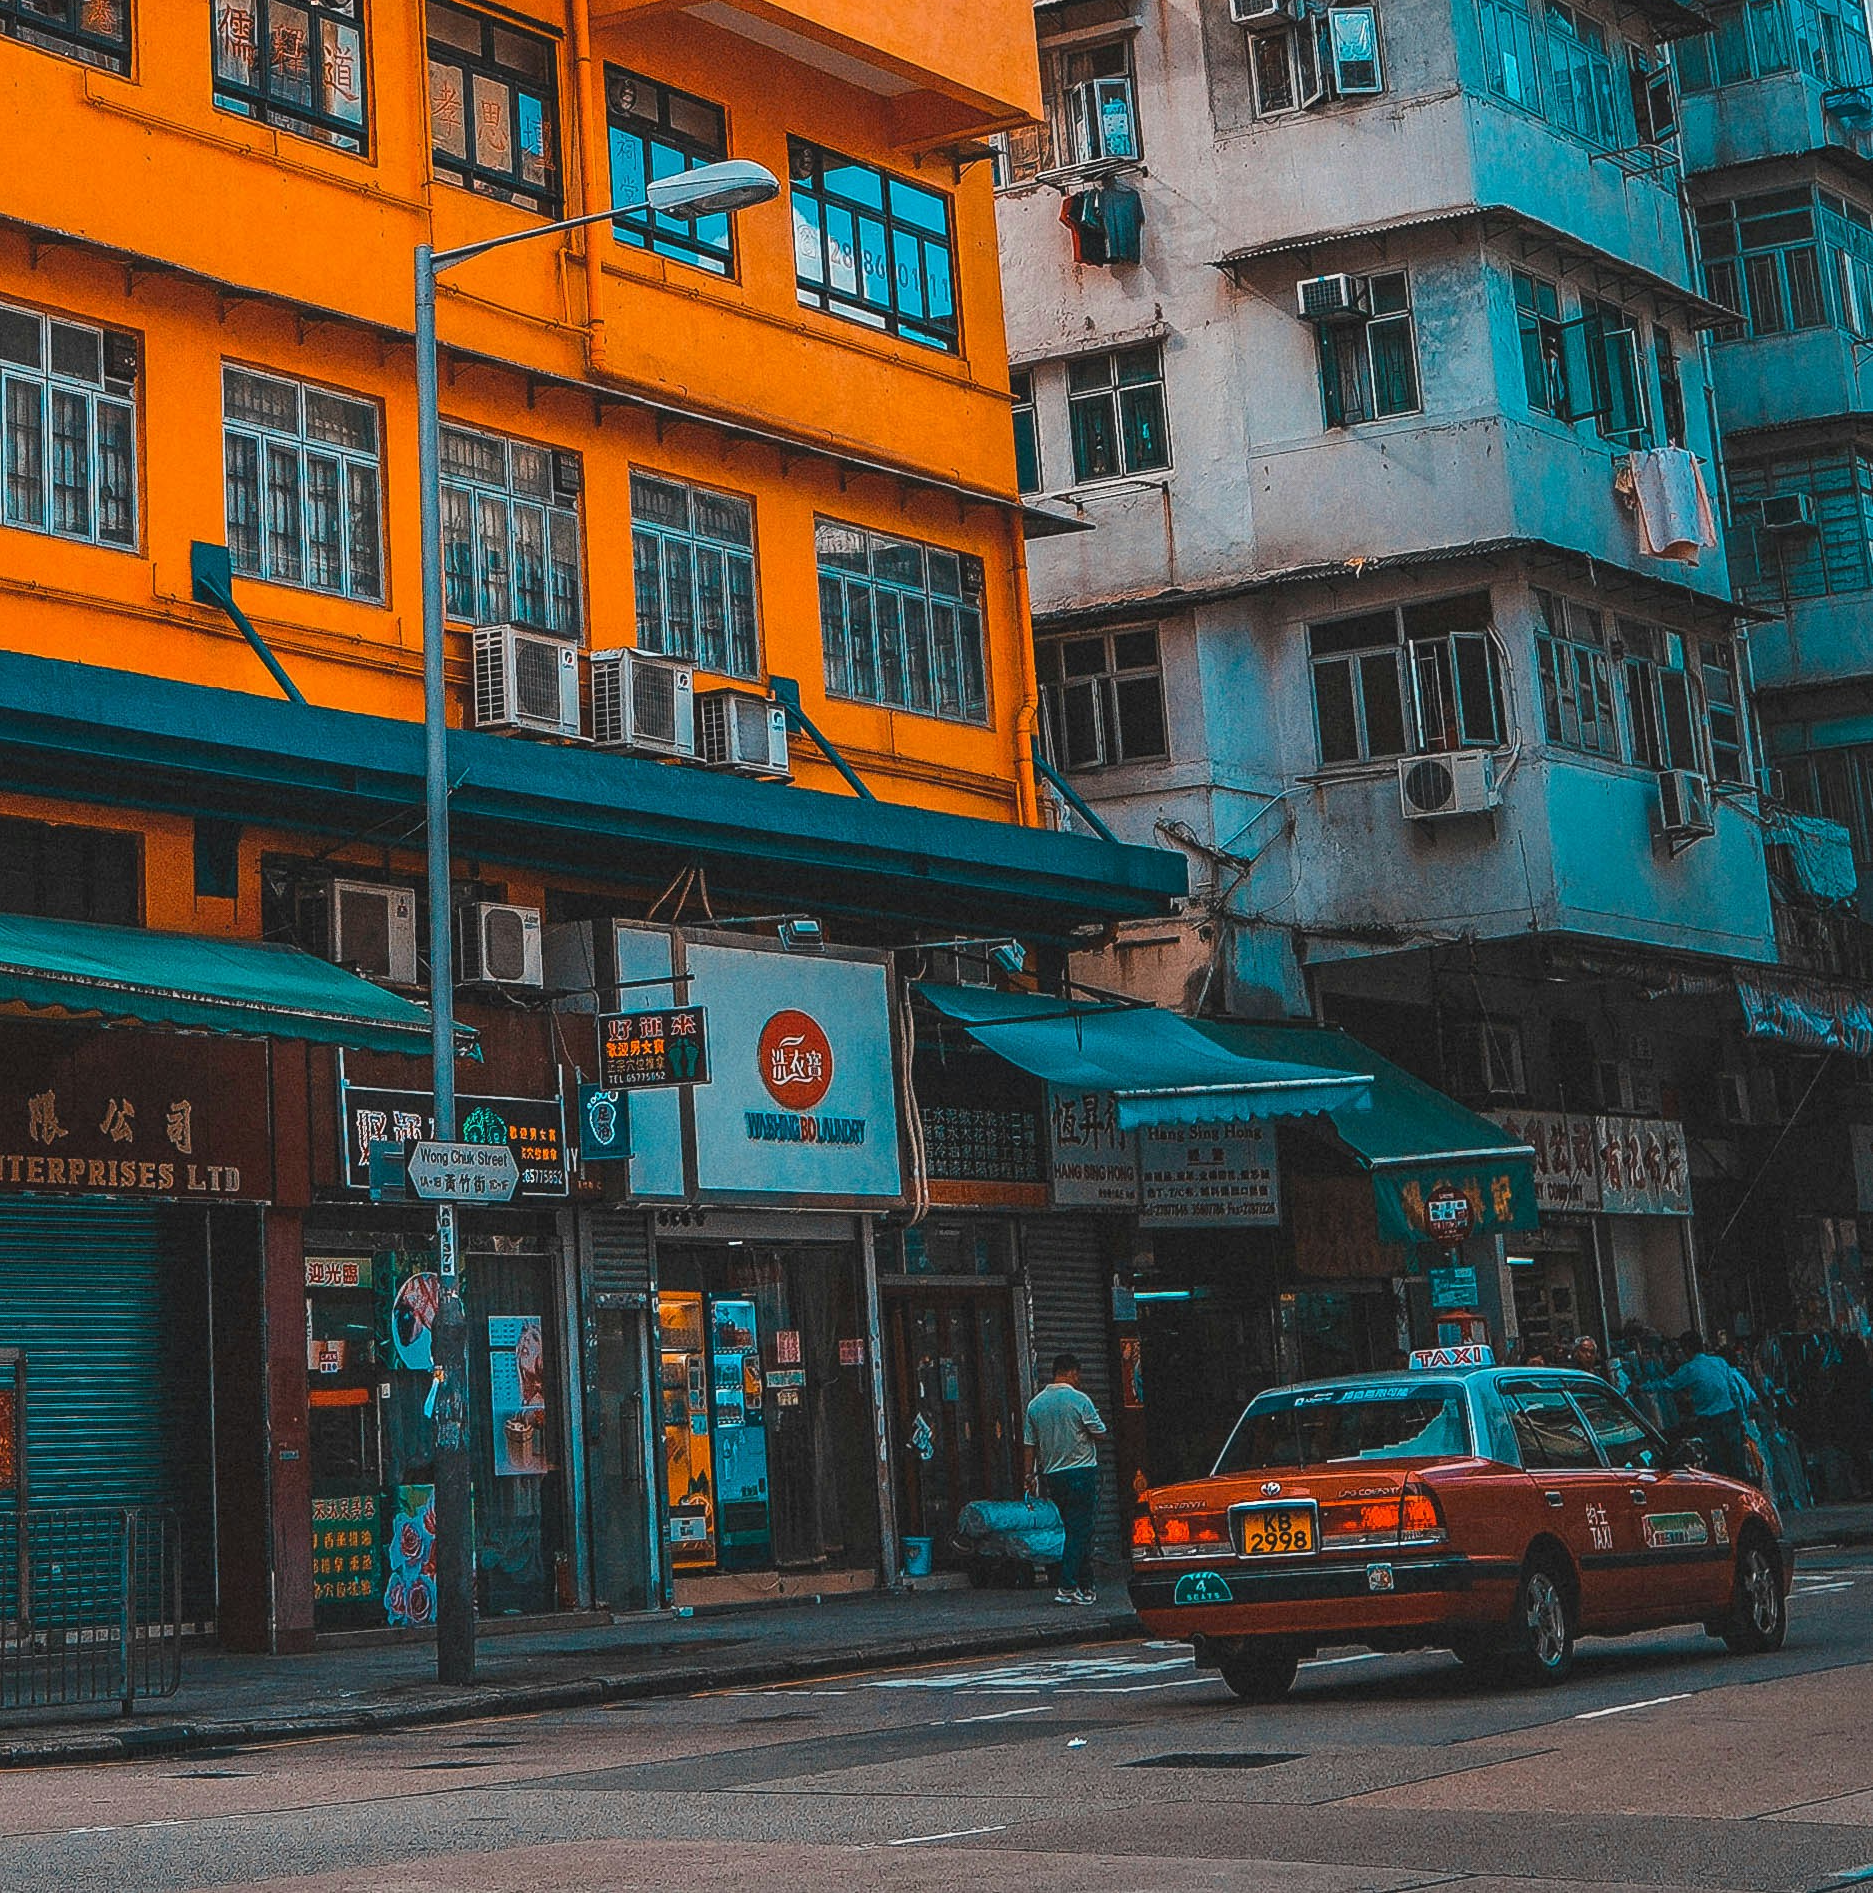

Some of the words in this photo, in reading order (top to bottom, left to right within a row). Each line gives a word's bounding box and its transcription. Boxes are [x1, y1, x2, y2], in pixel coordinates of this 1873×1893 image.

[1189, 1124, 1220, 1141] Sing
[1224, 1123, 1263, 1140] Hong
[420, 1147, 449, 1167] Wong
[450, 1149, 475, 1165] Chuk
[477, 1150, 508, 1168] Street
[187, 1164, 241, 1193] LTD
[1054, 1163, 1083, 1180] HANG
[1084, 1164, 1106, 1182] SING
[1107, 1165, 1135, 1182] HONG
[1416, 1345, 1482, 1368] TAXI
[1263, 1512, 1293, 1532] KB
[1250, 1530, 1308, 1553] 2998
[1590, 1526, 1613, 1550] TAXI
